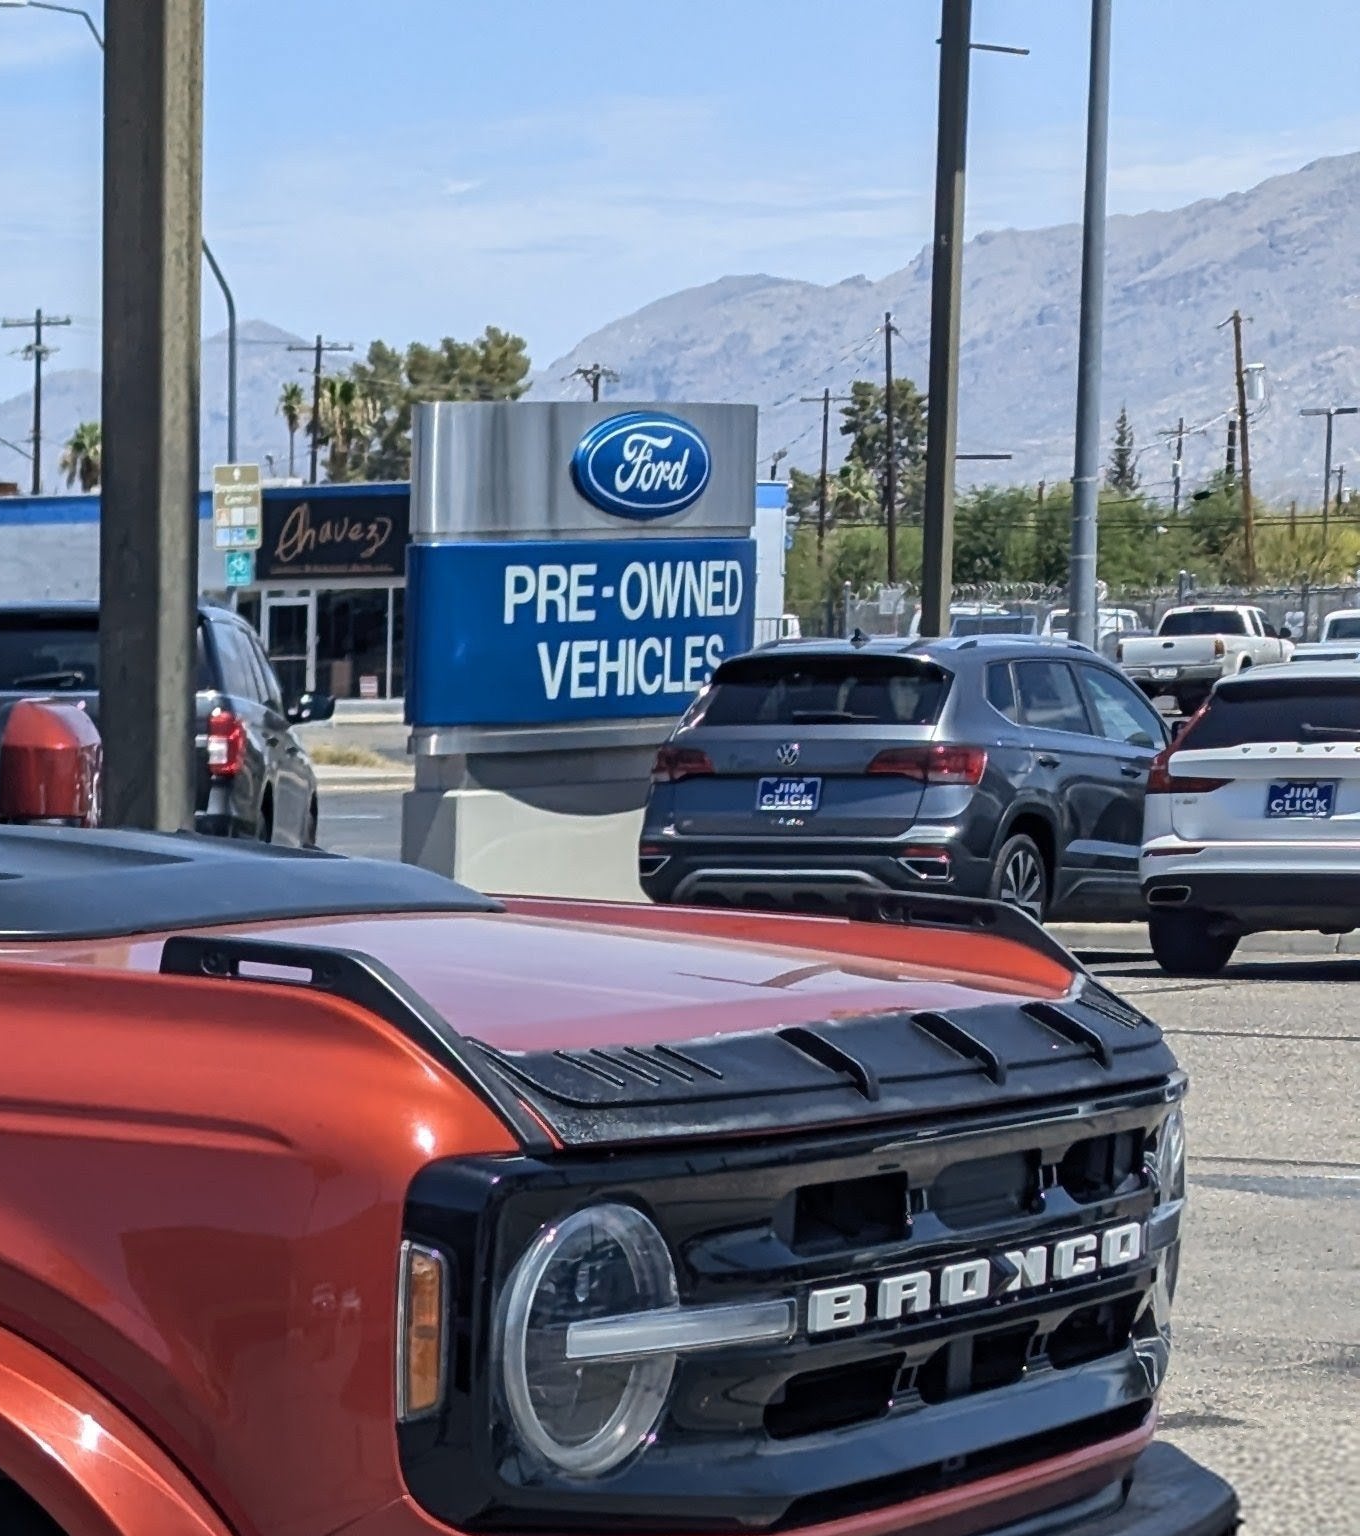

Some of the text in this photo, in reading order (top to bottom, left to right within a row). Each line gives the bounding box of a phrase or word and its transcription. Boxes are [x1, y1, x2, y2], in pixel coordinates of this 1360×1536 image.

[614, 433, 690, 493] Ford
[503, 559, 744, 625] PRE-OWNED
[537, 634, 725, 700] VEHICLES
[762, 794, 813, 805] CLICK
[774, 783, 805, 793] JIM
[1271, 799, 1327, 811] CLICK
[1284, 787, 1319, 798] JIM
[807, 1222, 1141, 1334] BRONCO
